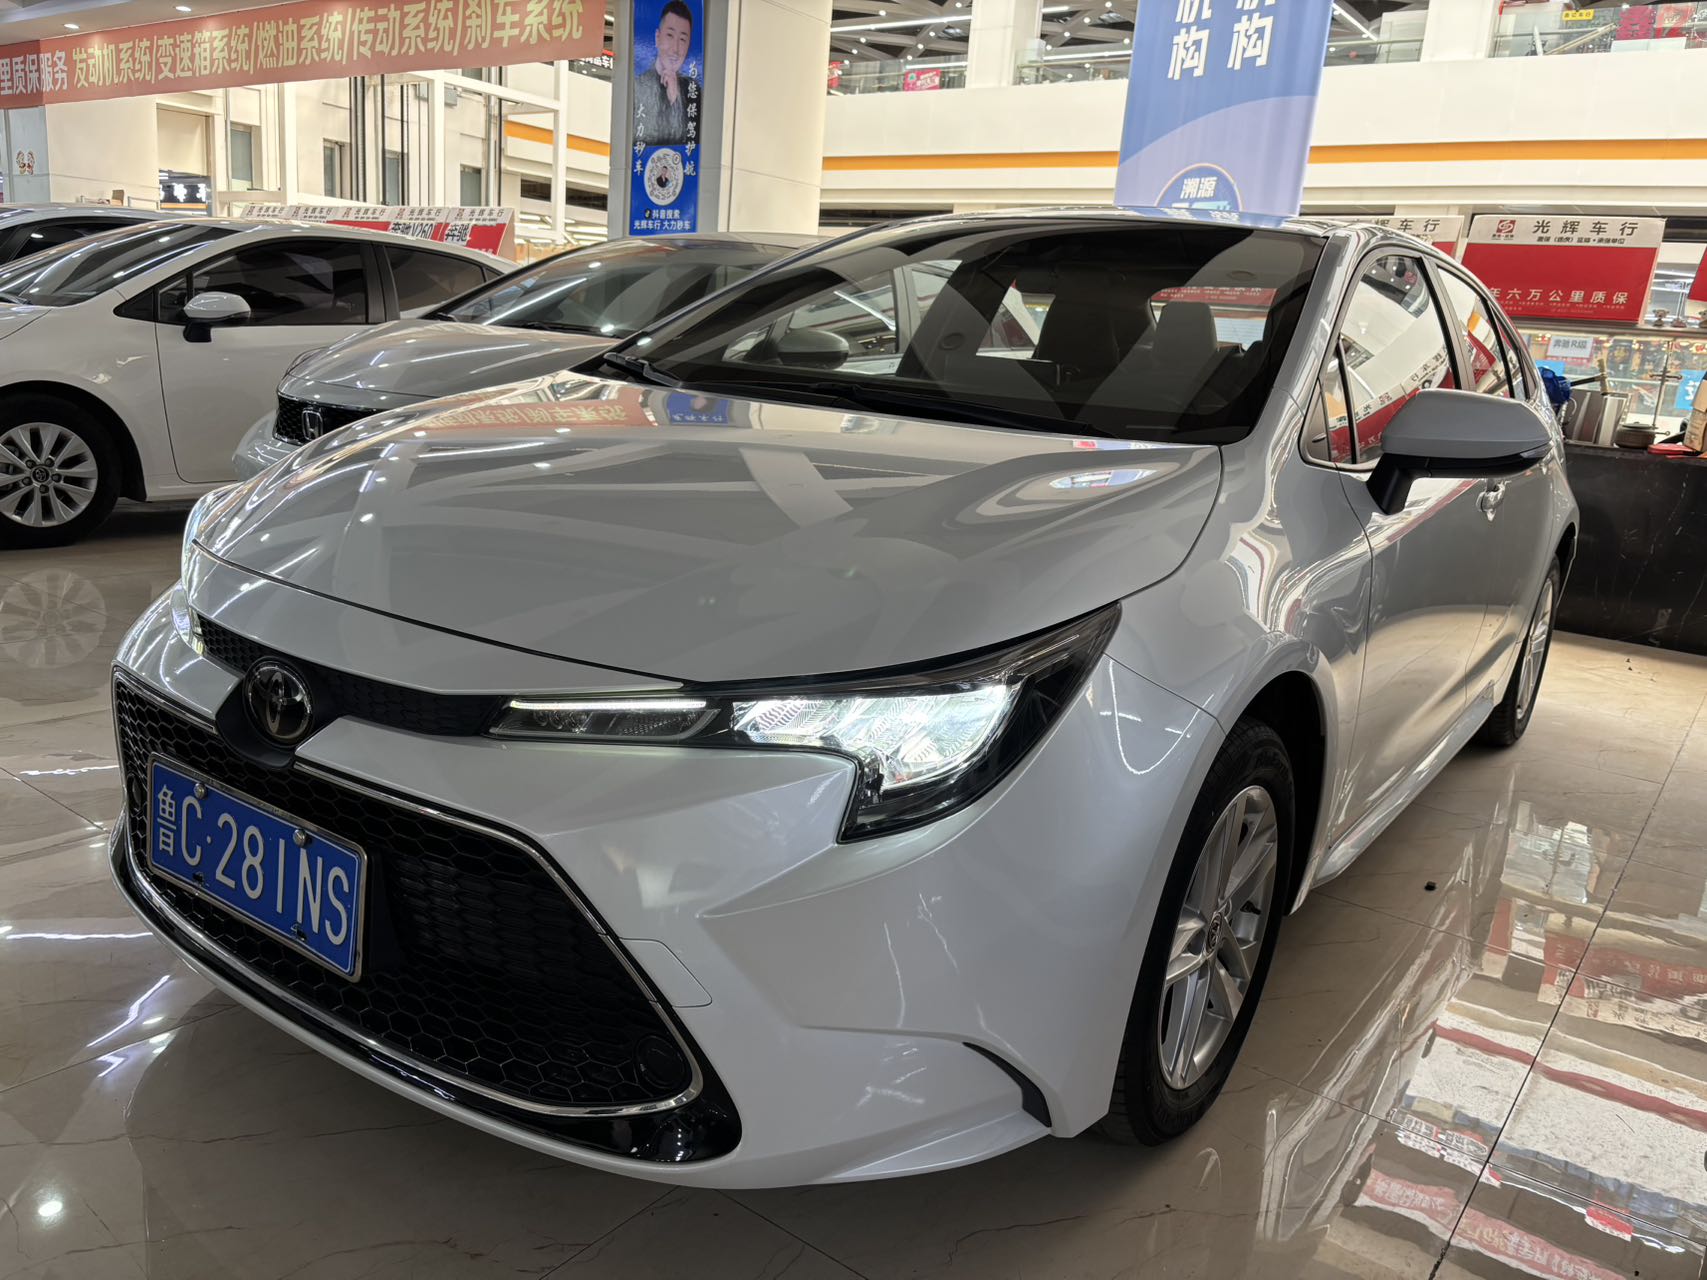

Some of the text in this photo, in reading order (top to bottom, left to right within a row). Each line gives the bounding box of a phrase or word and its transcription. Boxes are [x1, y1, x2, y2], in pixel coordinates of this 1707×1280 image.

[1227, 0, 1276, 70] 构
[0, 49, 68, 95] 里质保服务
[1180, 176, 1218, 199] 溯源
[1532, 219, 1639, 237] 光辉车行
